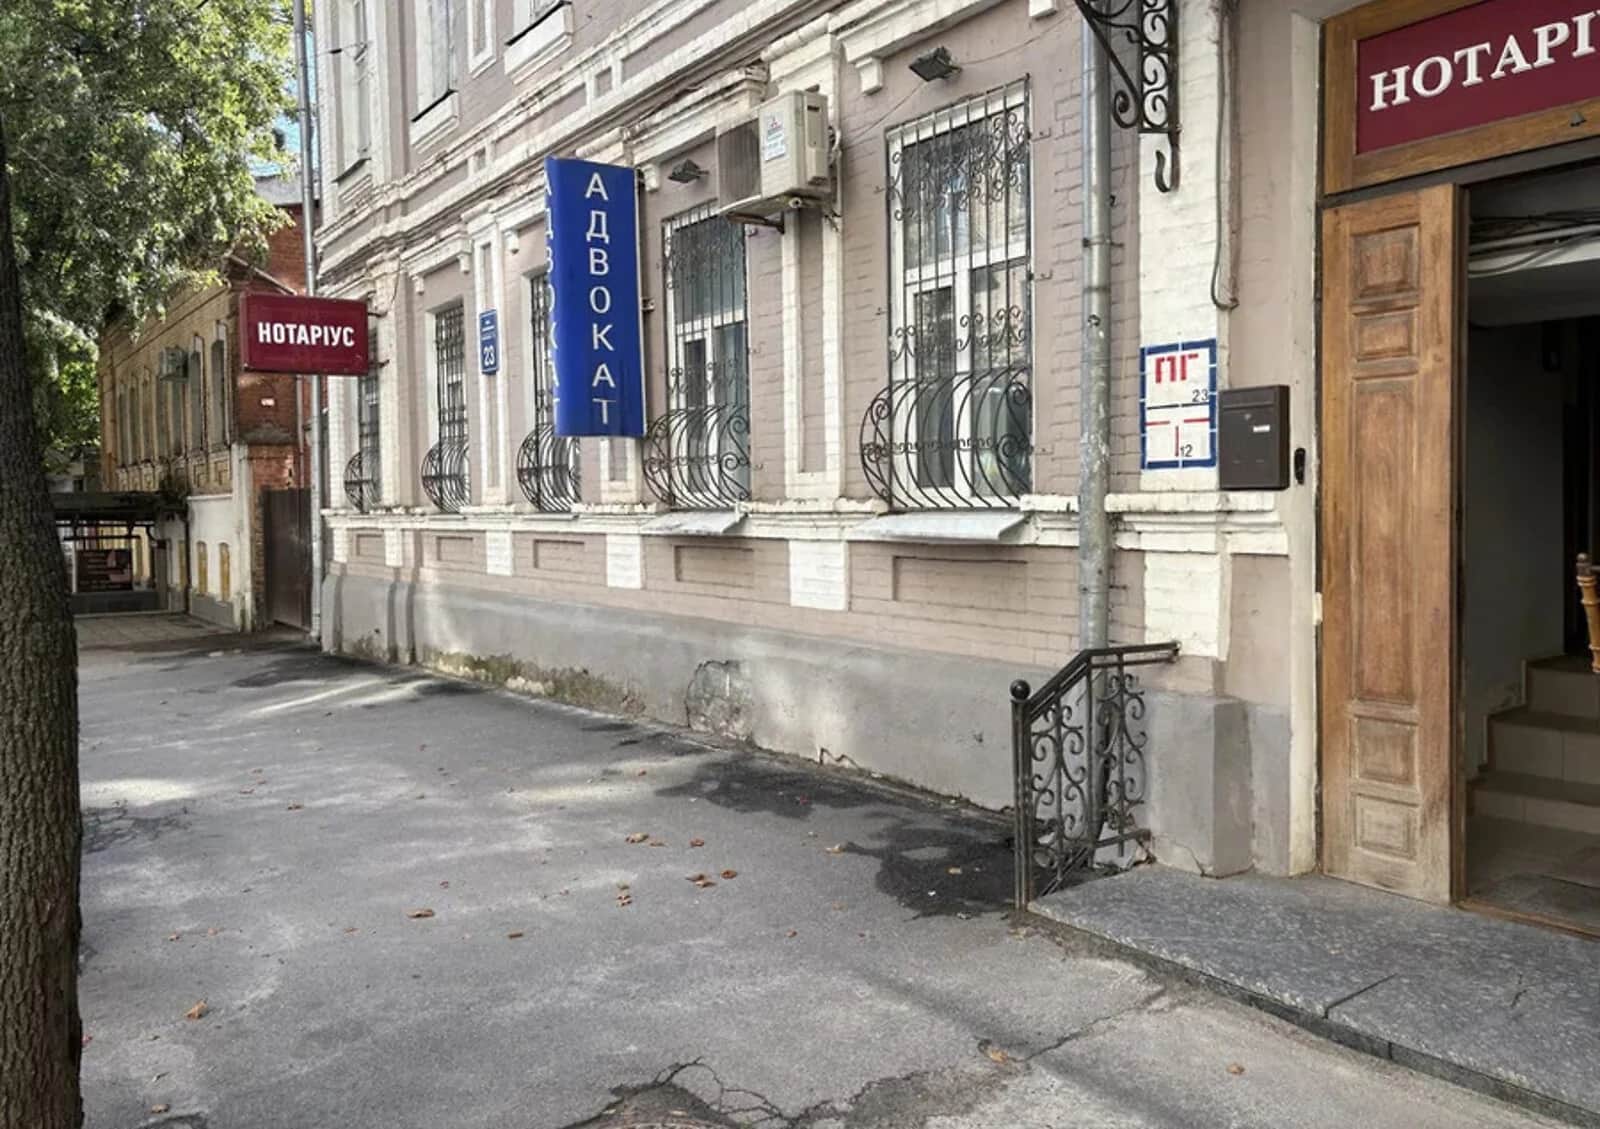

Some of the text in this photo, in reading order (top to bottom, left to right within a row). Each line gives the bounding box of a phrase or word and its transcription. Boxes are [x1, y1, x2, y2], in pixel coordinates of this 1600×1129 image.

[1369, 9, 1600, 111] НОТАРІ
[585, 172, 616, 424] АДВОКАТ
[258, 321, 355, 347] НОТАРІУС
[483, 344, 495, 367] 23
[1155, 353, 1199, 384] ПГ
[1191, 388, 1209, 403] 23
